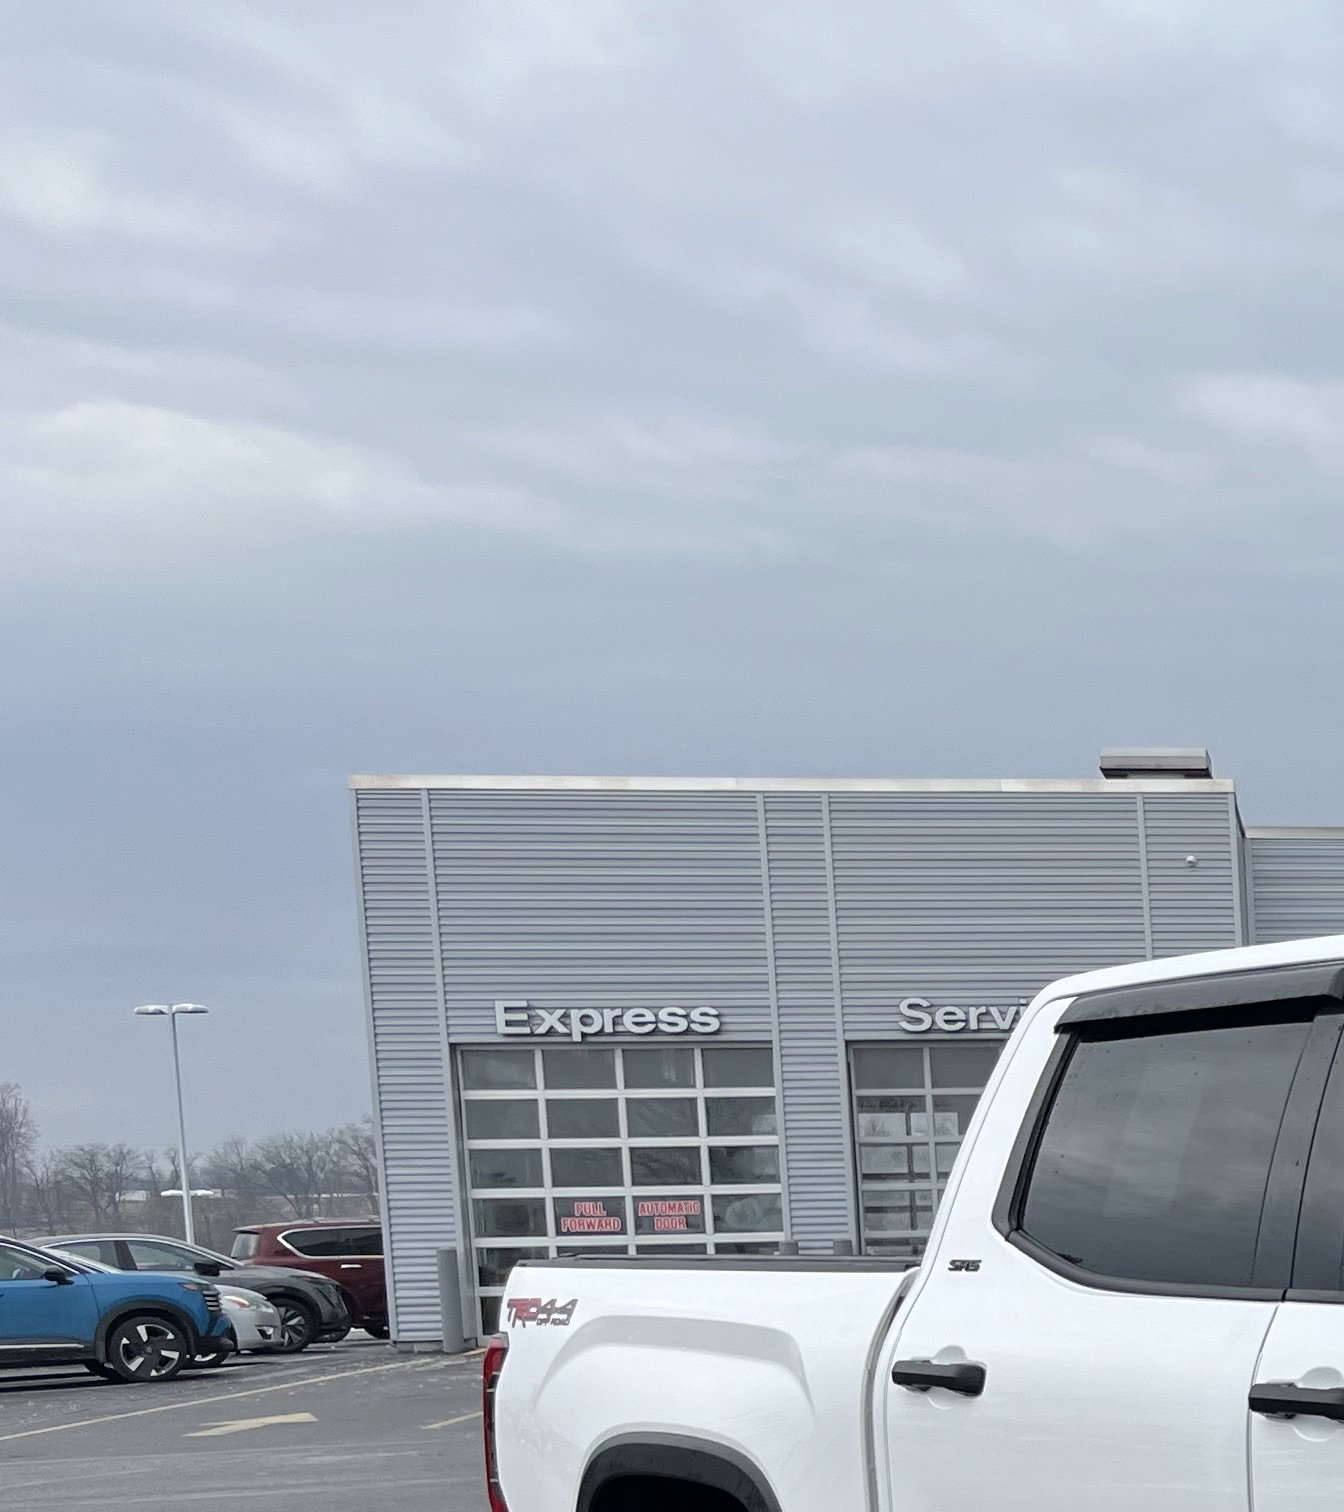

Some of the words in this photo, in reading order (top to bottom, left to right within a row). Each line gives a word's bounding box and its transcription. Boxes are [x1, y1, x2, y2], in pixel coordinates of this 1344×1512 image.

[495, 1000, 721, 1042] Express
[574, 1201, 607, 1217] PULL
[638, 1200, 701, 1216] AUTOMATIC
[560, 1216, 622, 1232] FORWARD
[654, 1216, 687, 1231] DOOR
